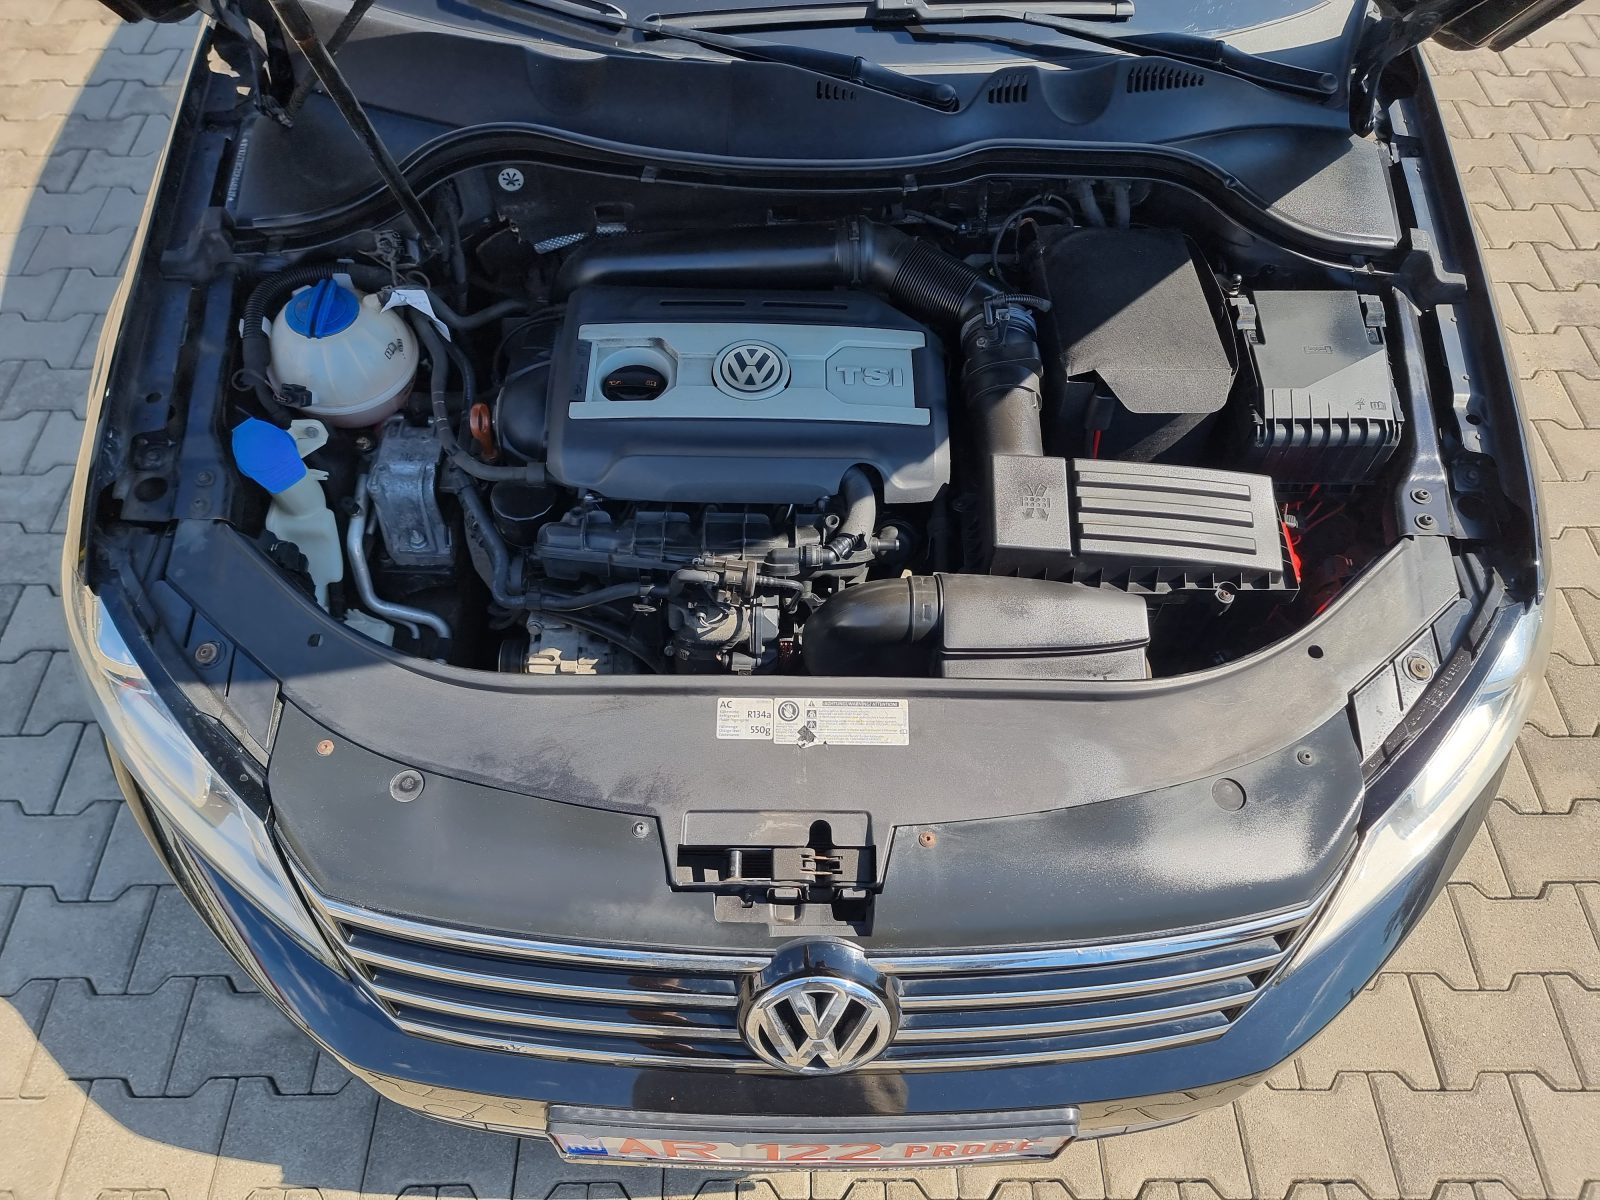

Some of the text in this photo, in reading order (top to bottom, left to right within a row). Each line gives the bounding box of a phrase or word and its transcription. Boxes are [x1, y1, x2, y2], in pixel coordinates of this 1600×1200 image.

[724, 345, 779, 390] VW
[836, 366, 903, 387] TSI
[719, 700, 733, 709] AC
[747, 710, 771, 719] R134a
[750, 725, 771, 737] 550g
[618, 1137, 720, 1159] AR
[756, 1143, 881, 1161] 122
[904, 1138, 1042, 1158] PROBE
